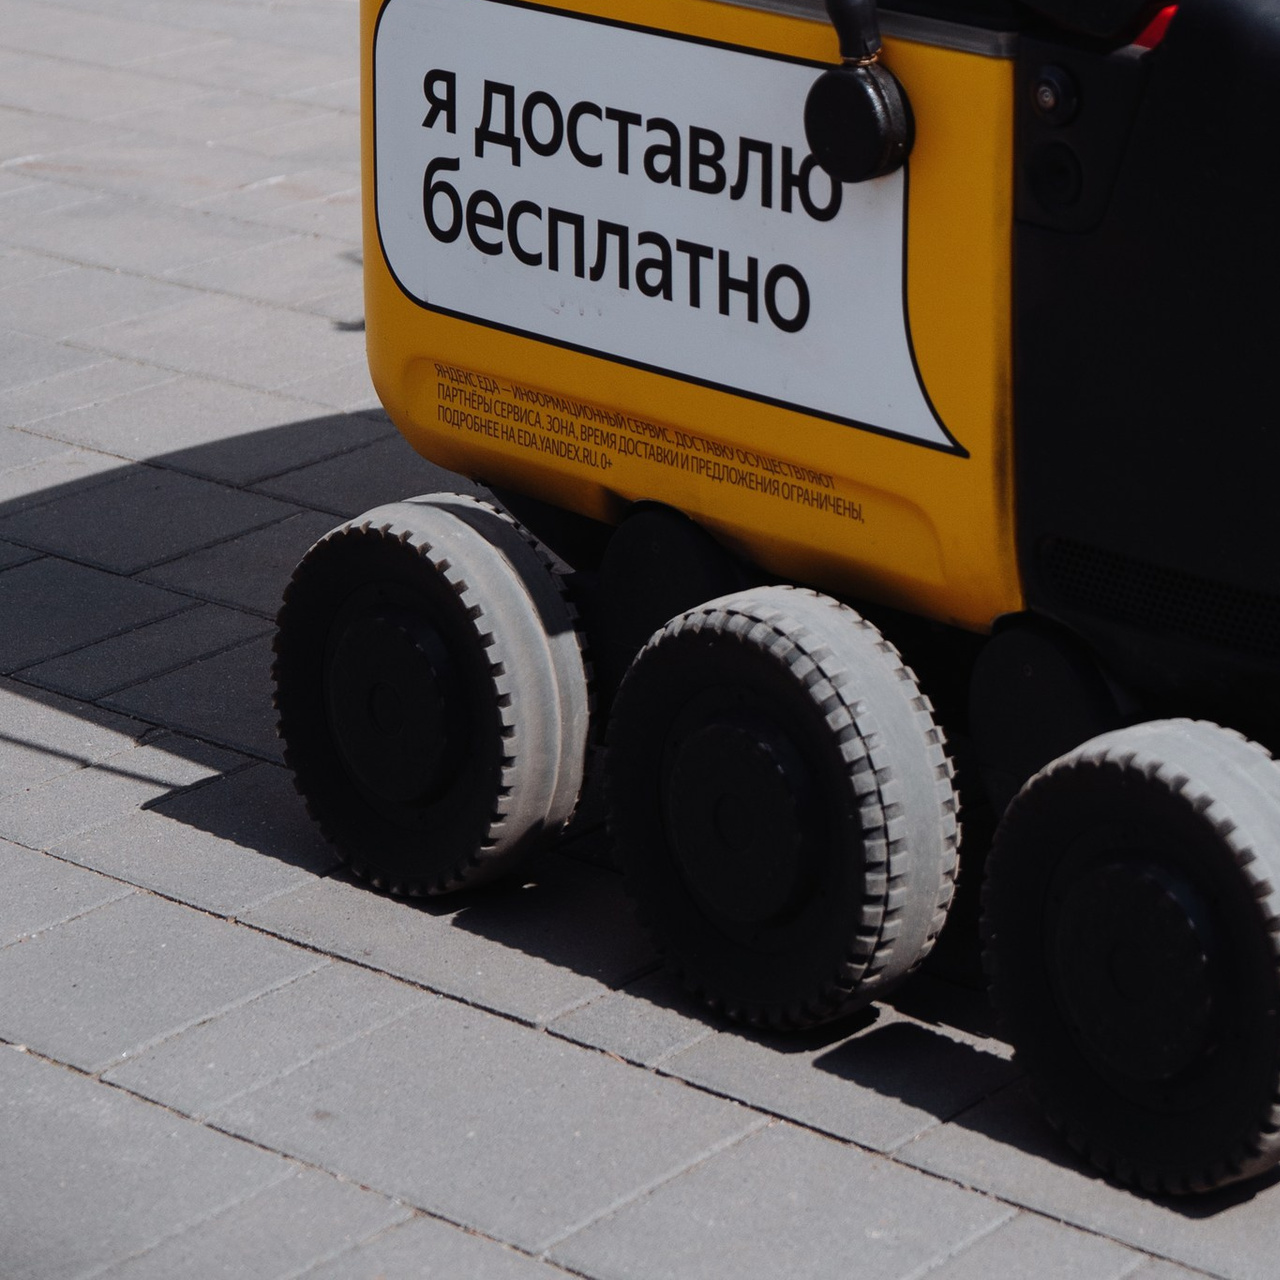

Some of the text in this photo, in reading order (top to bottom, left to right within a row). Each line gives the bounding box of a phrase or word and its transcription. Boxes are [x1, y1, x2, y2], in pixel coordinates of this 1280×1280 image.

[474, 79, 845, 222] доставлю
[422, 156, 811, 334] бесплатно
[434, 363, 478, 388] ЯНДЕКС
[478, 375, 501, 396] ЕДА
[511, 384, 628, 430] ИНФОРМАЦИОННЫЙ
[628, 416, 675, 444] СЕРВИС.
[675, 430, 734, 460] ДОСТАВКУ
[735, 448, 836, 490] ОСУЩЕСТВЛЯЮТ
[437, 404, 499, 439] ПОДРОБНЕЕ
[500, 424, 516, 444] НА
[600, 452, 613, 471] 0+
[437, 382, 865, 524] ПАРТНЁРЫ СЕРВИСА. ЗОНА, ВРЕМЯ ДОСТАВКИ И ПРЕДЛОЖЕНИЯ ОГРАНИЧЕНЫ,
